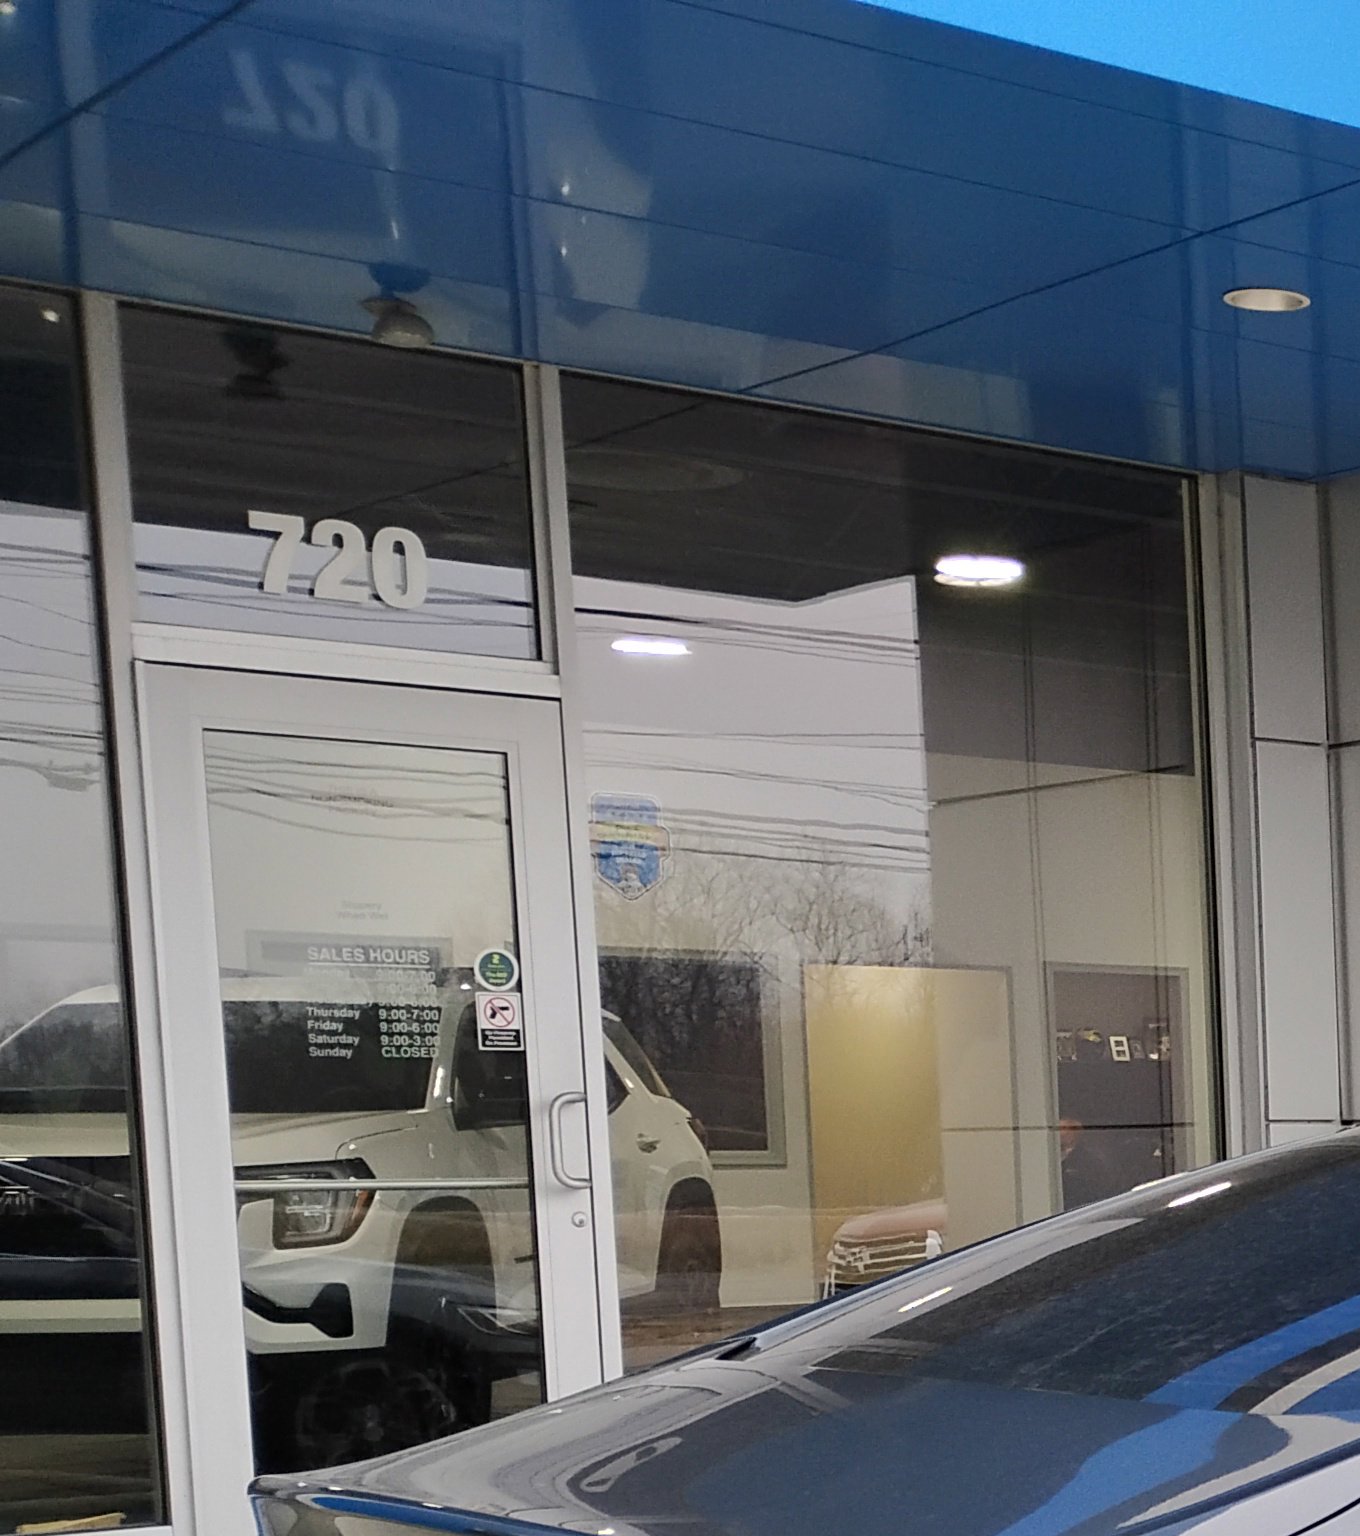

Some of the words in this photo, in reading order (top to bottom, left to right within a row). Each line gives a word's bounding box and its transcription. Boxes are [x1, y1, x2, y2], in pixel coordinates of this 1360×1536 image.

[248, 510, 428, 609] 720
[307, 946, 365, 962] SALES
[369, 948, 430, 964] HOURS
[306, 1006, 361, 1020] Thursday
[378, 1008, 439, 1020] 9:00-7:00
[307, 1020, 344, 1032] Friday
[379, 1021, 440, 1033] 9:00-6:00
[308, 1033, 360, 1046] Saturday
[380, 1034, 441, 1046] 9:00-3:00
[309, 1046, 353, 1059] Sunday
[381, 1046, 438, 1058] CLOSED
